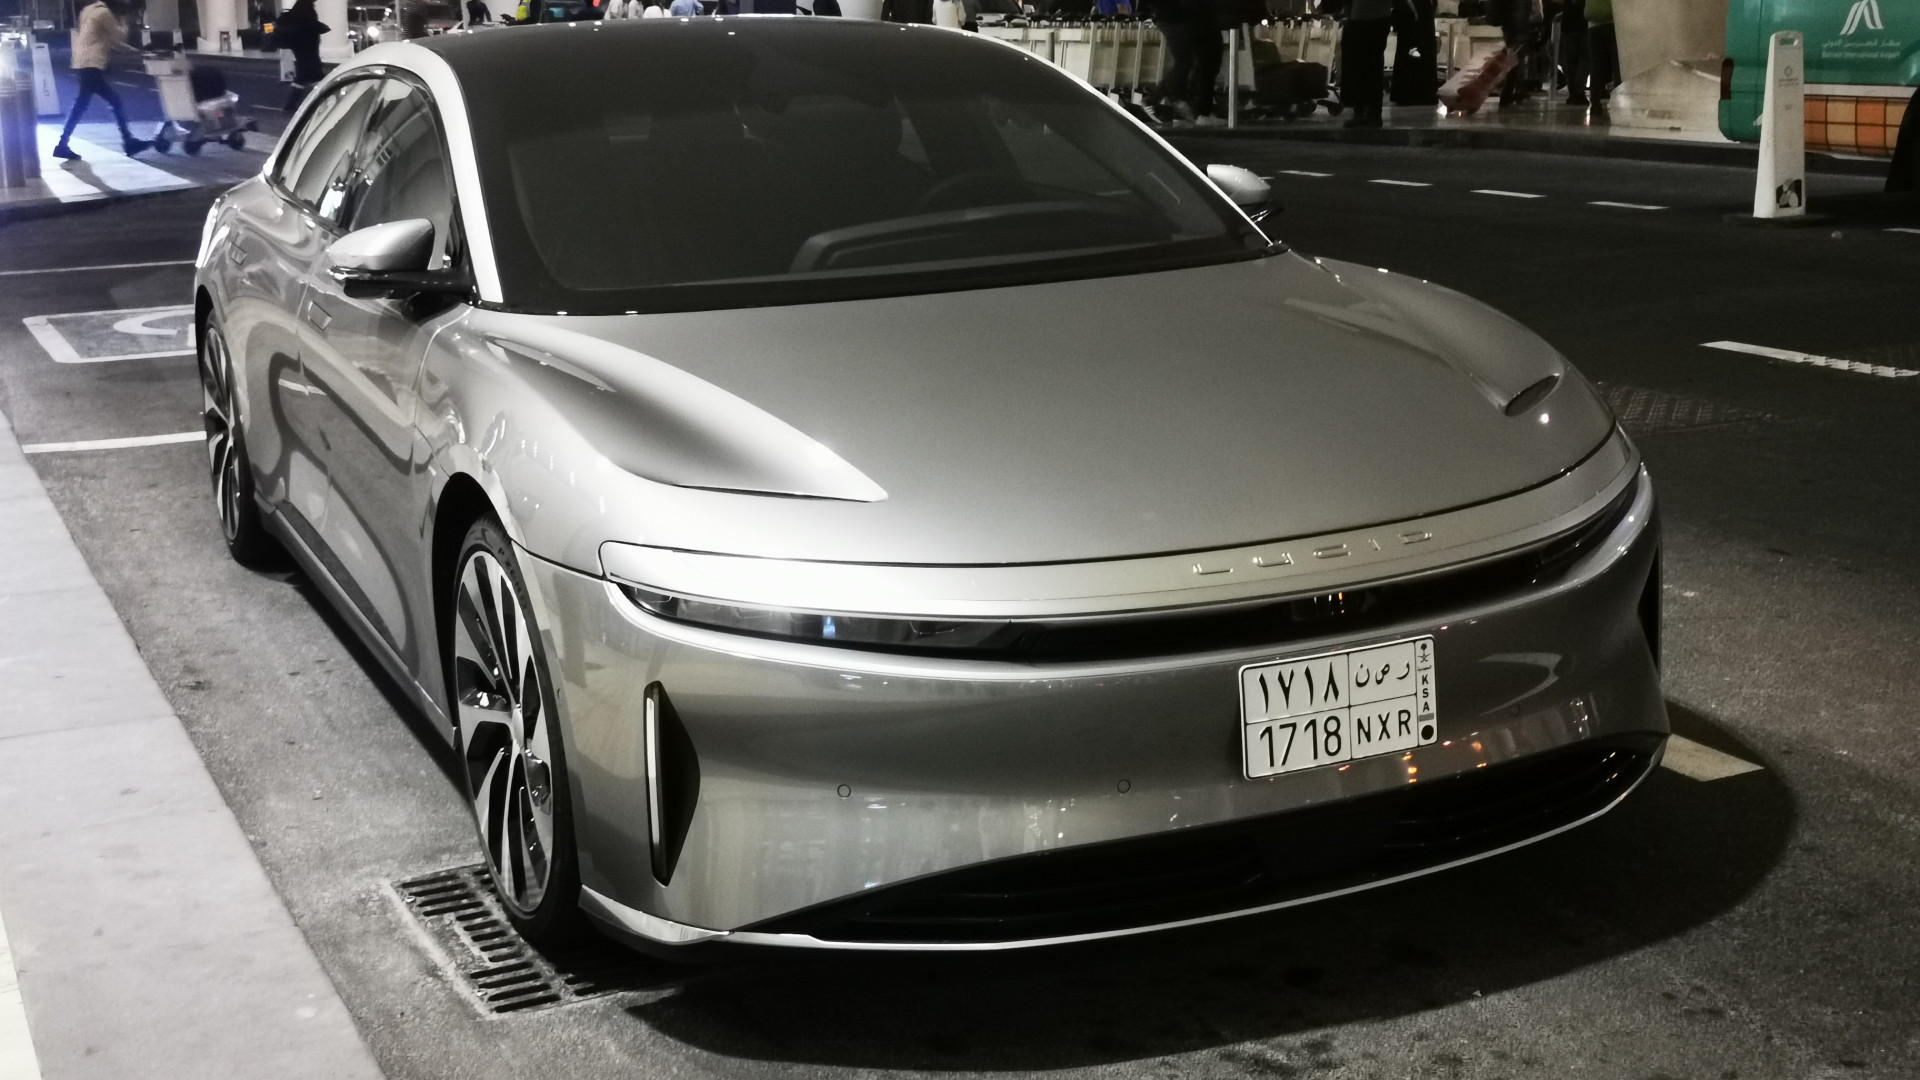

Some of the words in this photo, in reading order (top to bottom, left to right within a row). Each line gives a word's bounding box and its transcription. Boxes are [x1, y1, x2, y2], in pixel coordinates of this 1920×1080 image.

[1192, 530, 1433, 576] LUCID
[1258, 661, 1340, 713] ١٧١٨
[1421, 673, 1431, 713] KSA
[1259, 715, 1342, 768] 1718
[1356, 709, 1411, 745] NXR
